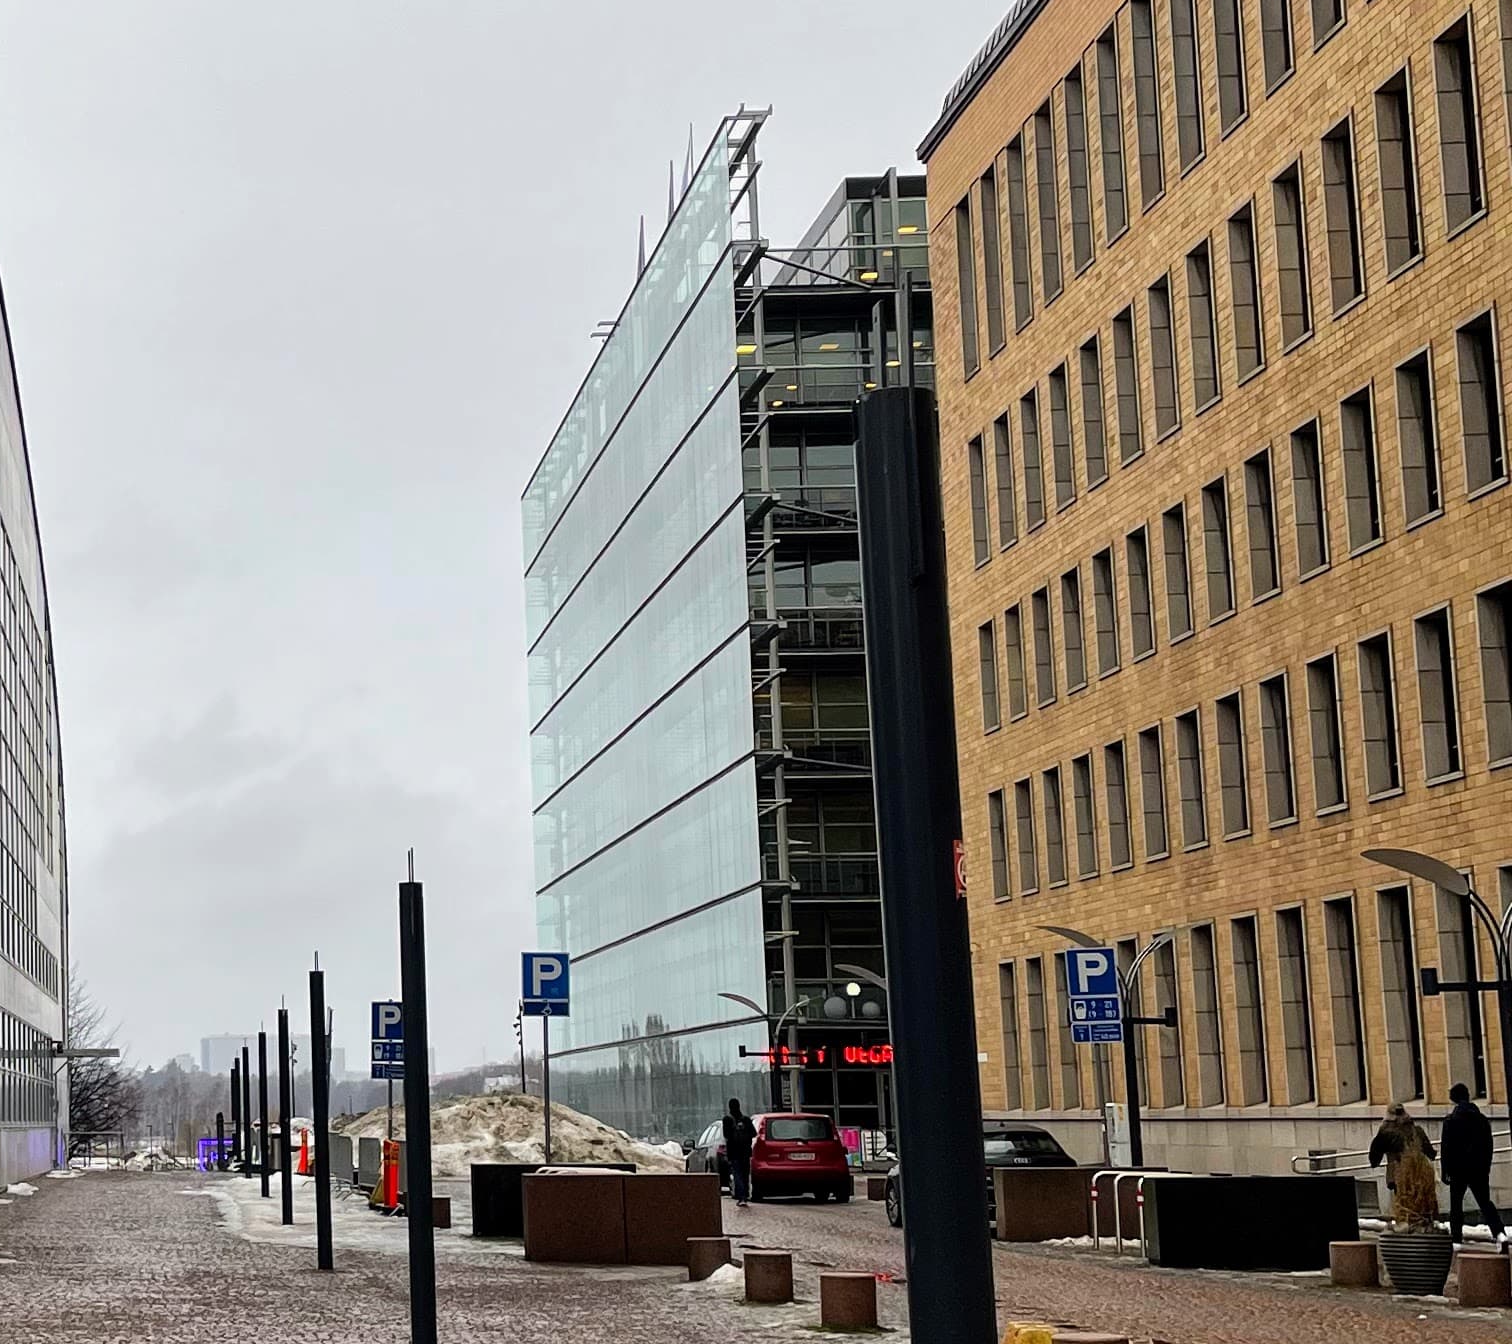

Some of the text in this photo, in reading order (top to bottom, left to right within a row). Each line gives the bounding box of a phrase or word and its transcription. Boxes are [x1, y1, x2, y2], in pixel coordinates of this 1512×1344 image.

[533, 957, 562, 996] P
[1076, 952, 1108, 993] P
[379, 1005, 401, 1038] P
